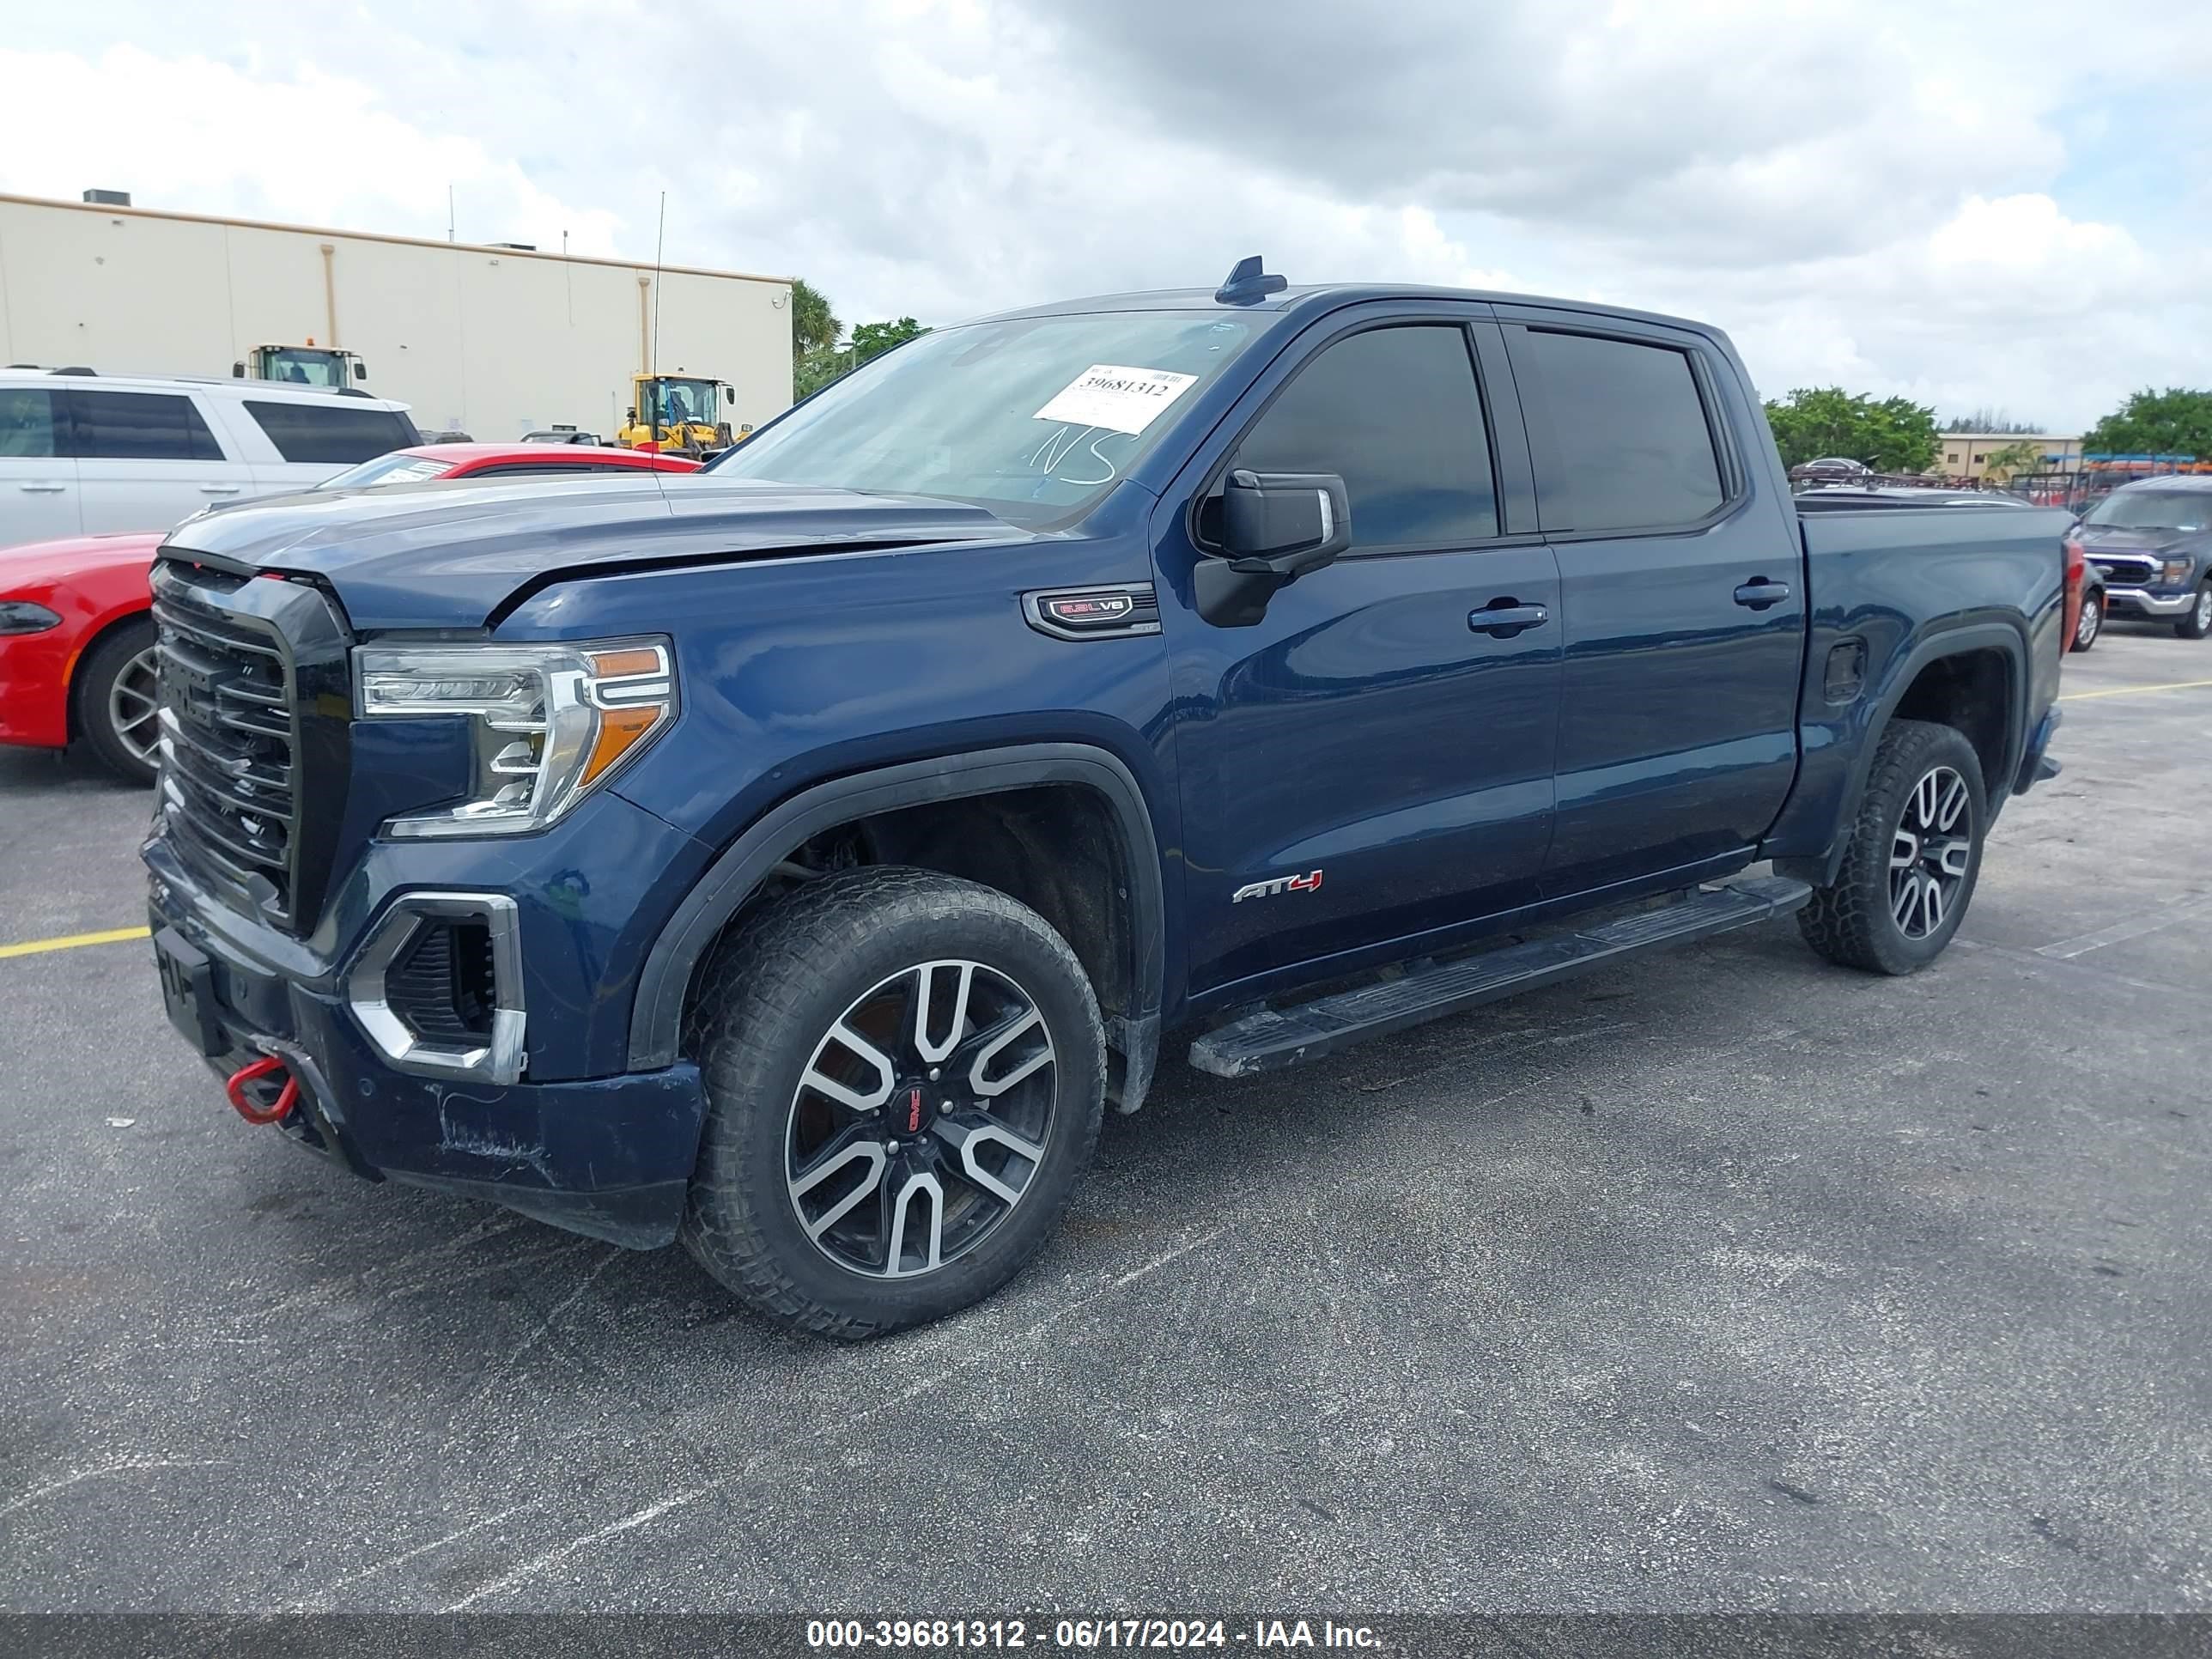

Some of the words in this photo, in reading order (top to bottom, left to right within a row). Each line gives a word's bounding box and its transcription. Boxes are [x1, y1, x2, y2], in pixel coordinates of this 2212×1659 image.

[1079, 376, 1169, 397] 39681312
[1232, 870, 1323, 903] AT4
[908, 1089, 921, 1132] GMC
